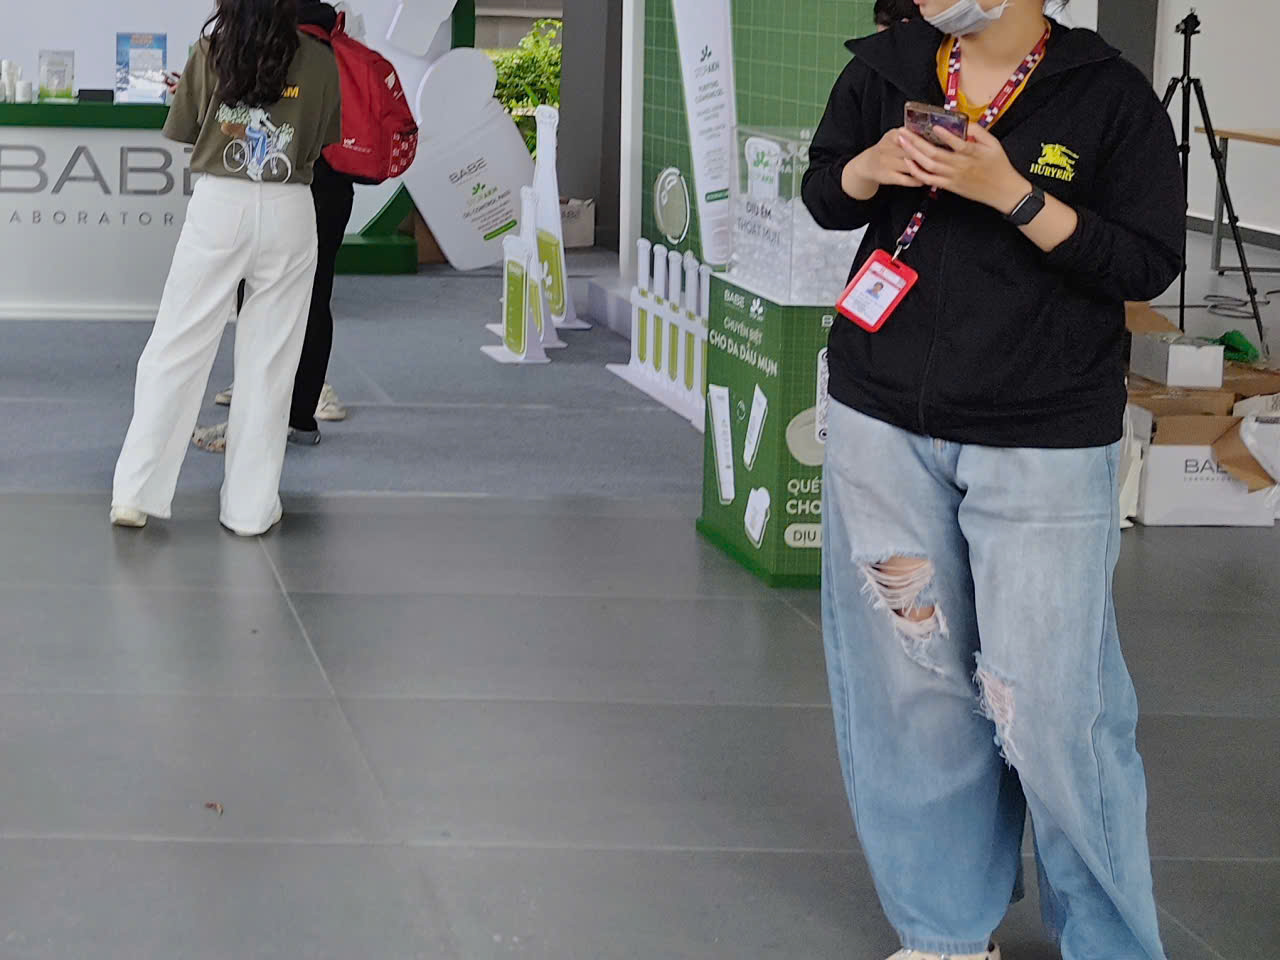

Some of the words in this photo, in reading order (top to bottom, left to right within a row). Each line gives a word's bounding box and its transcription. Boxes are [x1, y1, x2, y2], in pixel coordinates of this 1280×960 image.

[449, 157, 488, 184] BABE
[709, 328, 727, 351] CHO
[728, 337, 739, 358] DA
